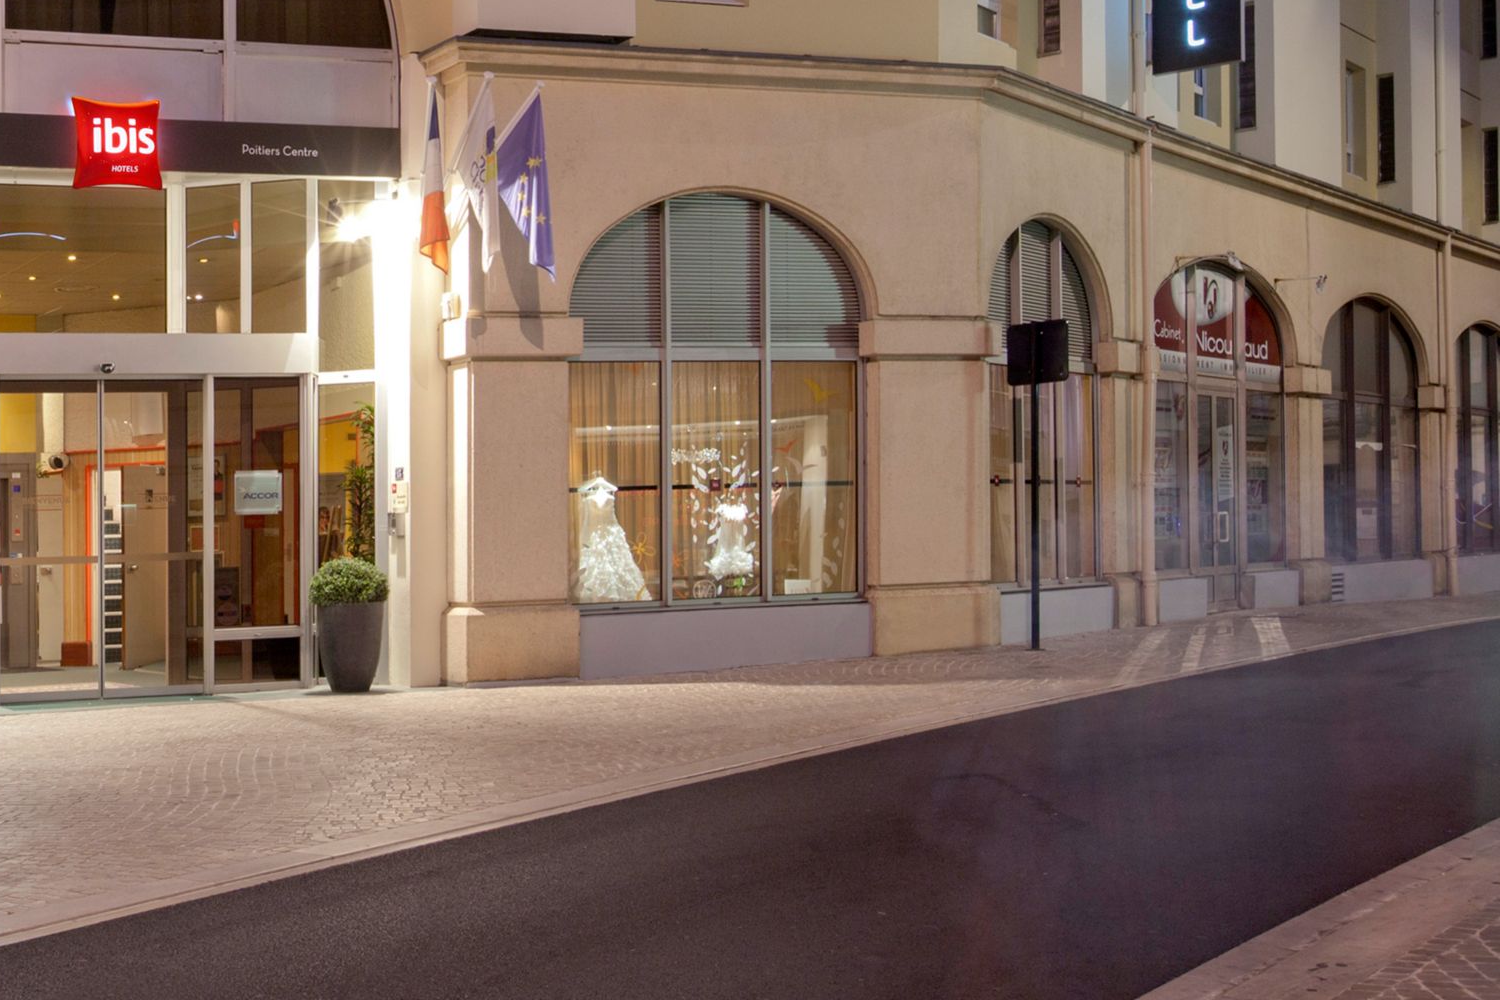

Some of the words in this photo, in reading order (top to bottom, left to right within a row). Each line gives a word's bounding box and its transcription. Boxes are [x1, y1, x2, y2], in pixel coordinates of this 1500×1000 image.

[93, 117, 155, 155] ibis
[242, 143, 280, 156] Poitiers
[282, 145, 319, 157] Centre
[111, 165, 139, 173] HOTELS
[1196, 330, 1269, 360] Nicouaud
[243, 492, 278, 500] ACCOR
